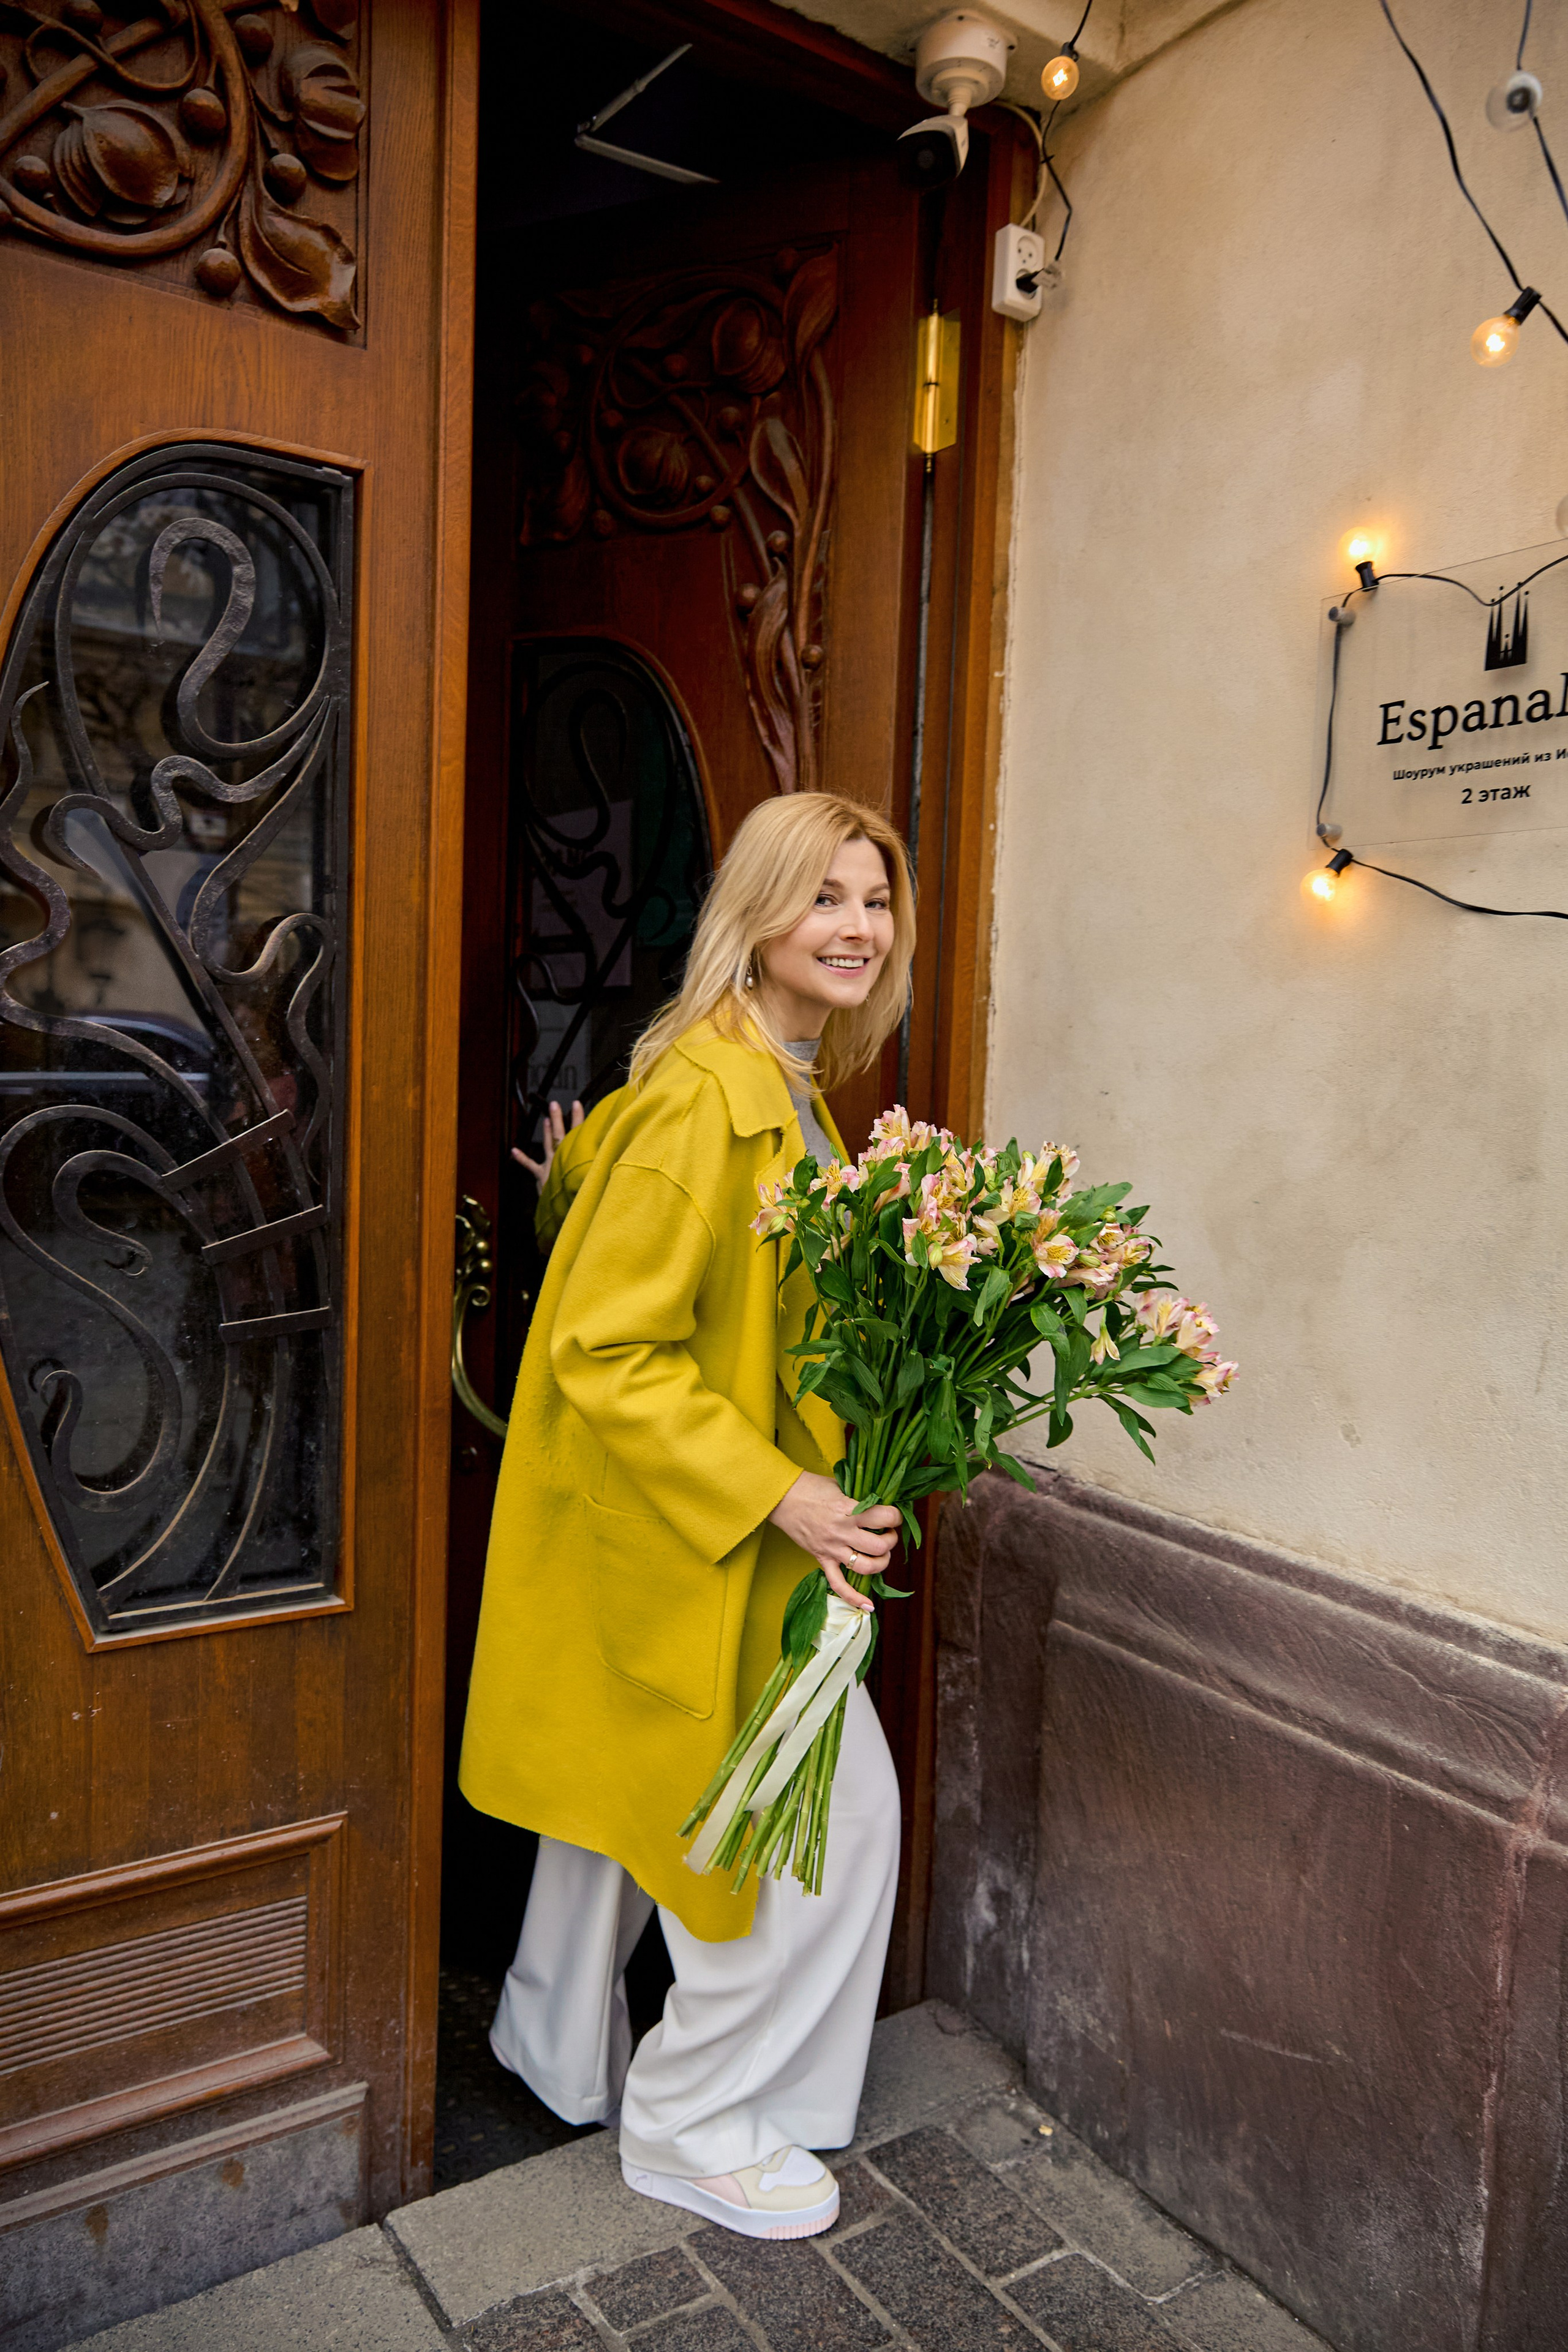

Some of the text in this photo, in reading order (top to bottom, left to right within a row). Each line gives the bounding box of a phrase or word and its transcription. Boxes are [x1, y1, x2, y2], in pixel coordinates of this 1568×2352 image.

[1376, 672, 1568, 750] Espana
[1393, 748, 1568, 781] Шоурум украшений из И
[1461, 785, 1531, 804] 2 этаж
